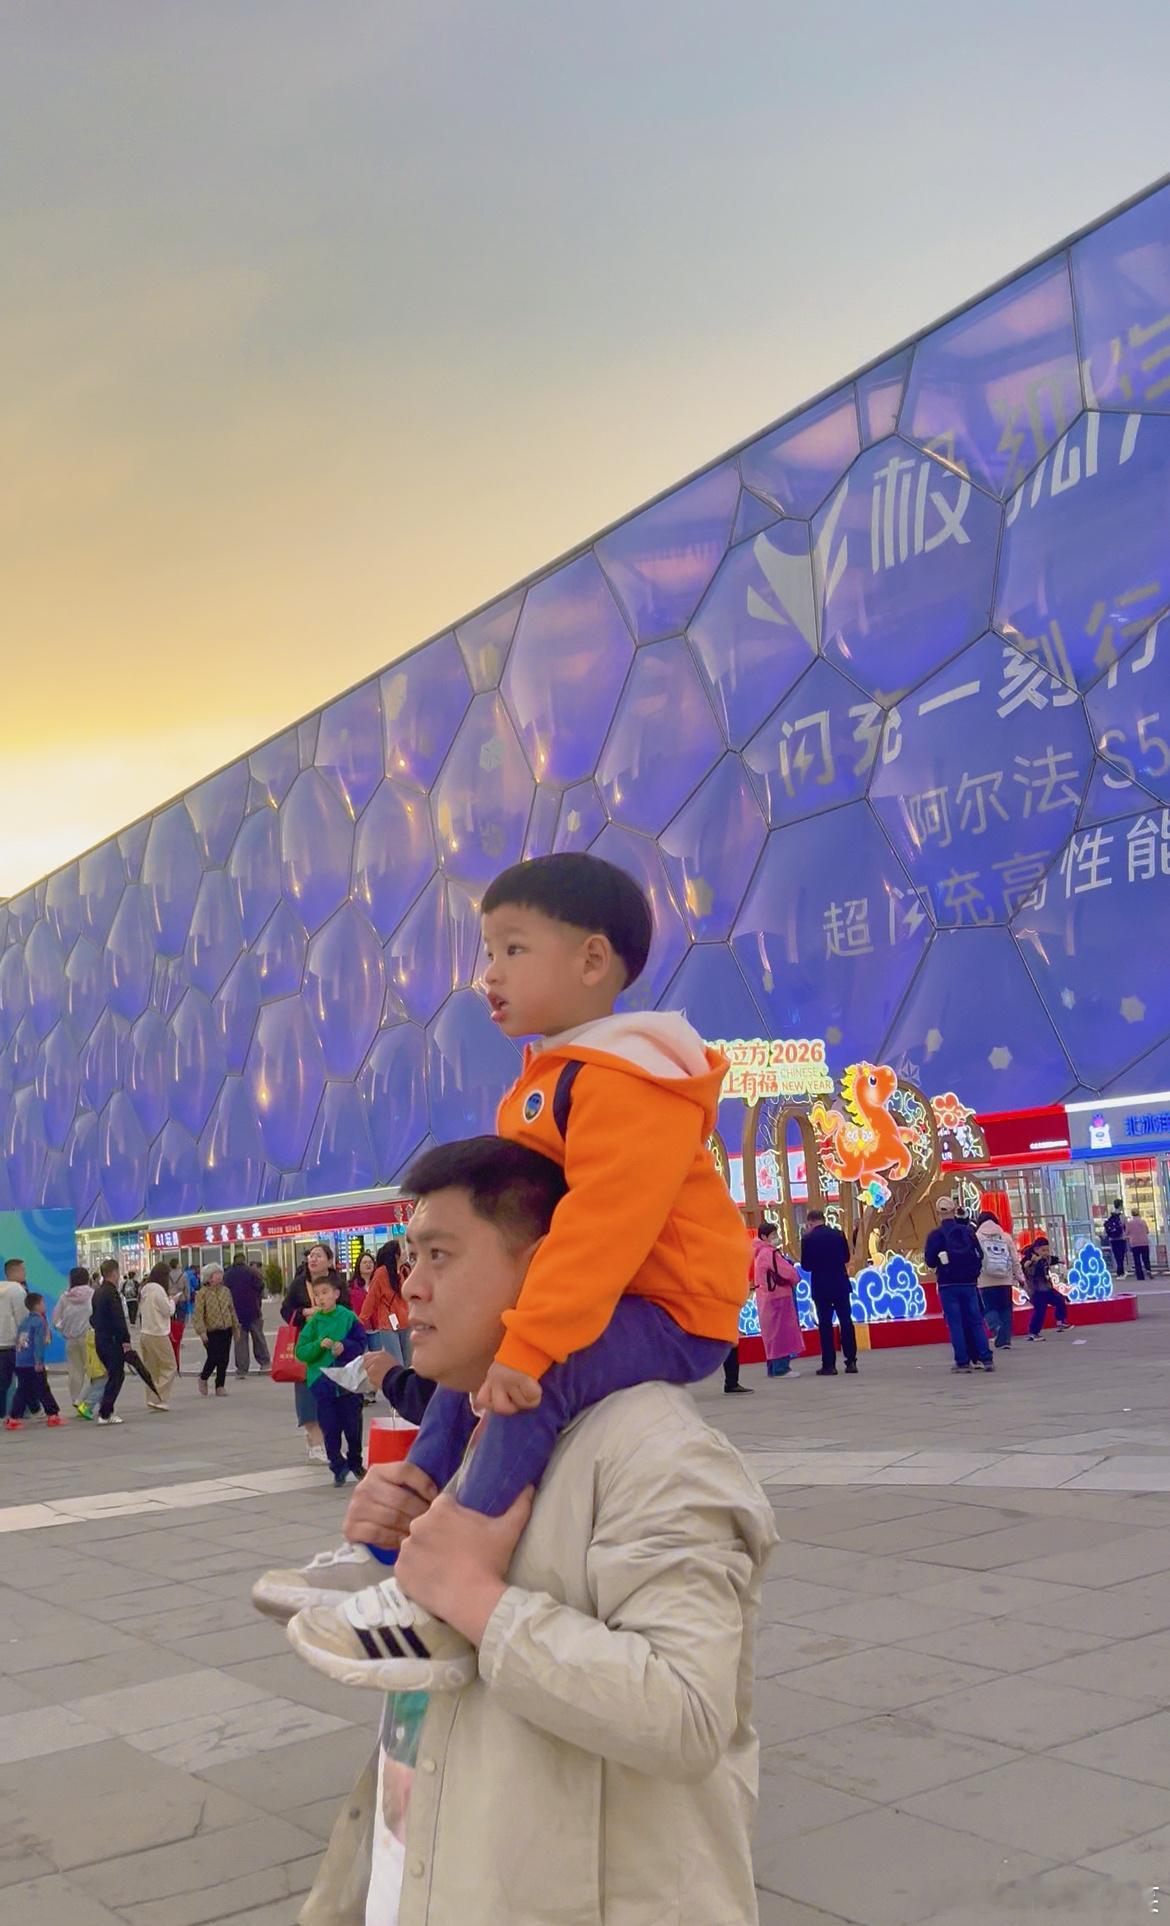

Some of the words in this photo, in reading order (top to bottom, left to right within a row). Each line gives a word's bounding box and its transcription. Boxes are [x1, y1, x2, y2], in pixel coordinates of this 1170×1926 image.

[772, 1042, 823, 1064] 2026
[723, 1070, 779, 1102] 上有福
[782, 1081, 804, 1092] NEW
[808, 1080, 832, 1091] YEAR
